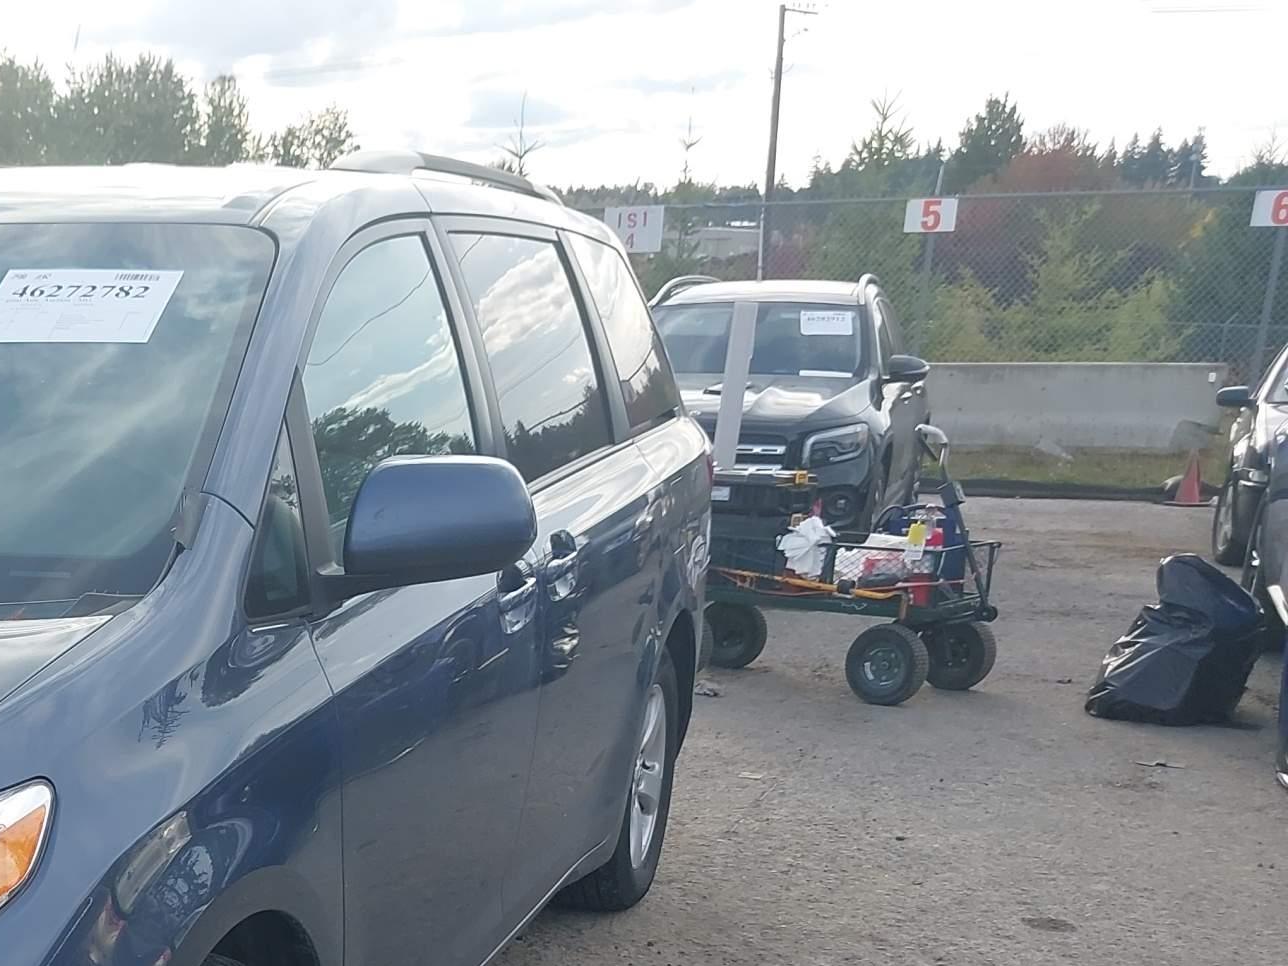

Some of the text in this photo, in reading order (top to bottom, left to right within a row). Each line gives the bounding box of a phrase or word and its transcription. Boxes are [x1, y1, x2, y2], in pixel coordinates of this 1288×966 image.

[920, 200, 942, 231] 5
[1271, 191, 1288, 225] 6
[12, 284, 151, 299] 46272782
